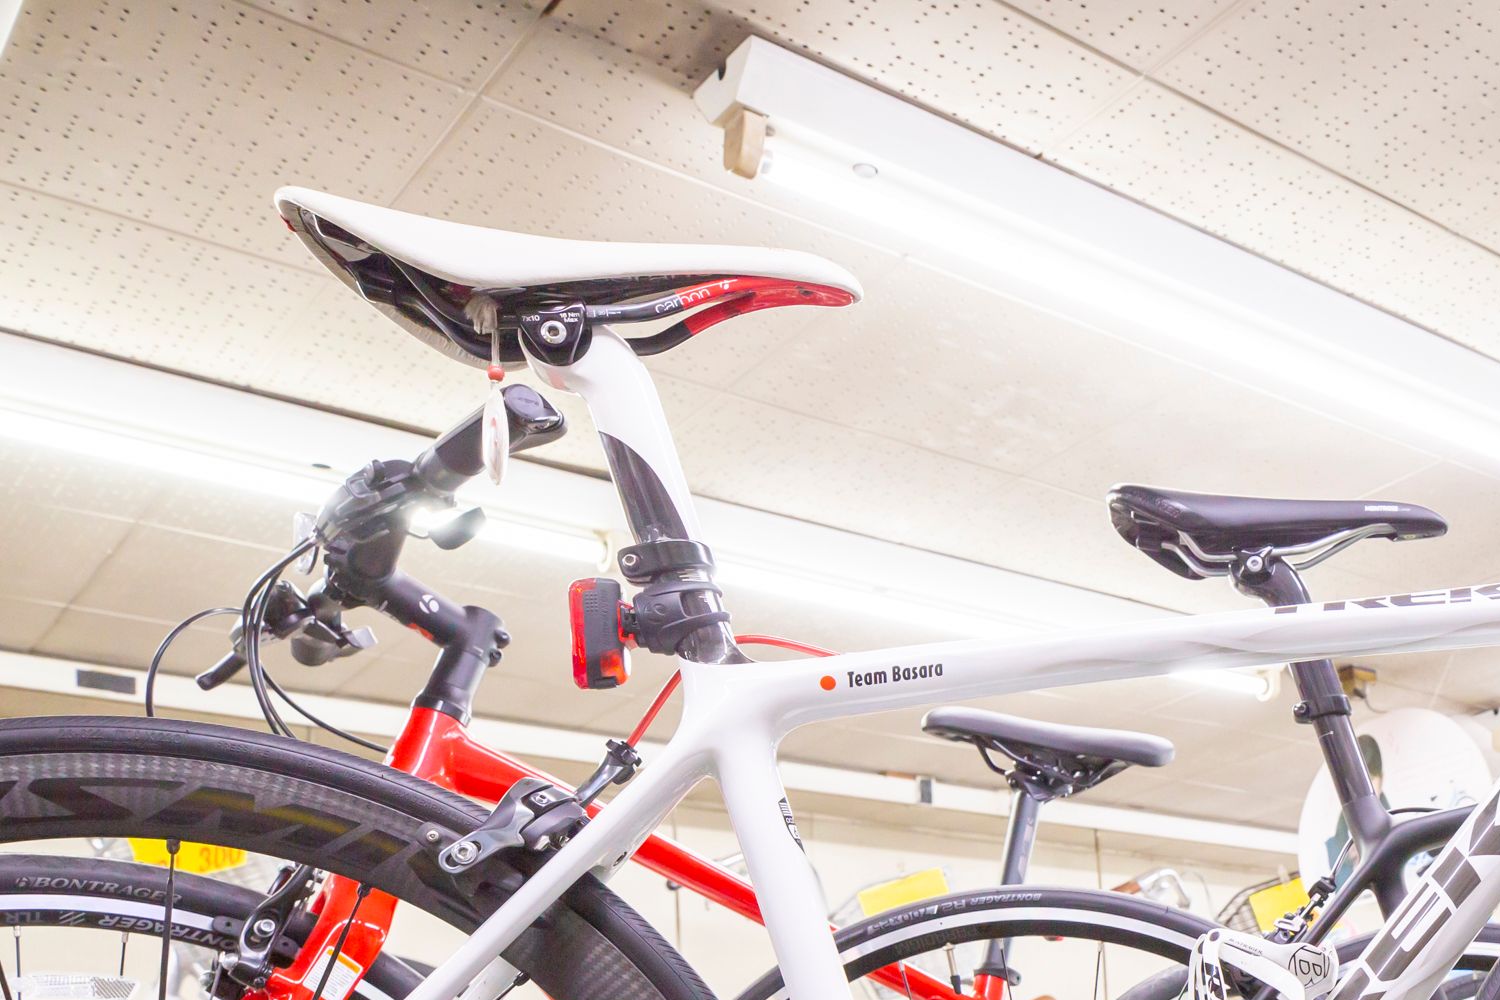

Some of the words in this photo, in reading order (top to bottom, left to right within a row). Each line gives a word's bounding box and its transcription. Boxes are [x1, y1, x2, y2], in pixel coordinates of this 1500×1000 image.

[655, 288, 711, 314] carbon
[847, 667, 888, 688] Team
[892, 661, 943, 684] Basara
[34, 876, 183, 904] BONTRAGER
[971, 892, 1042, 906] BONTRAGER
[97, 912, 239, 951] ONTRAGER
